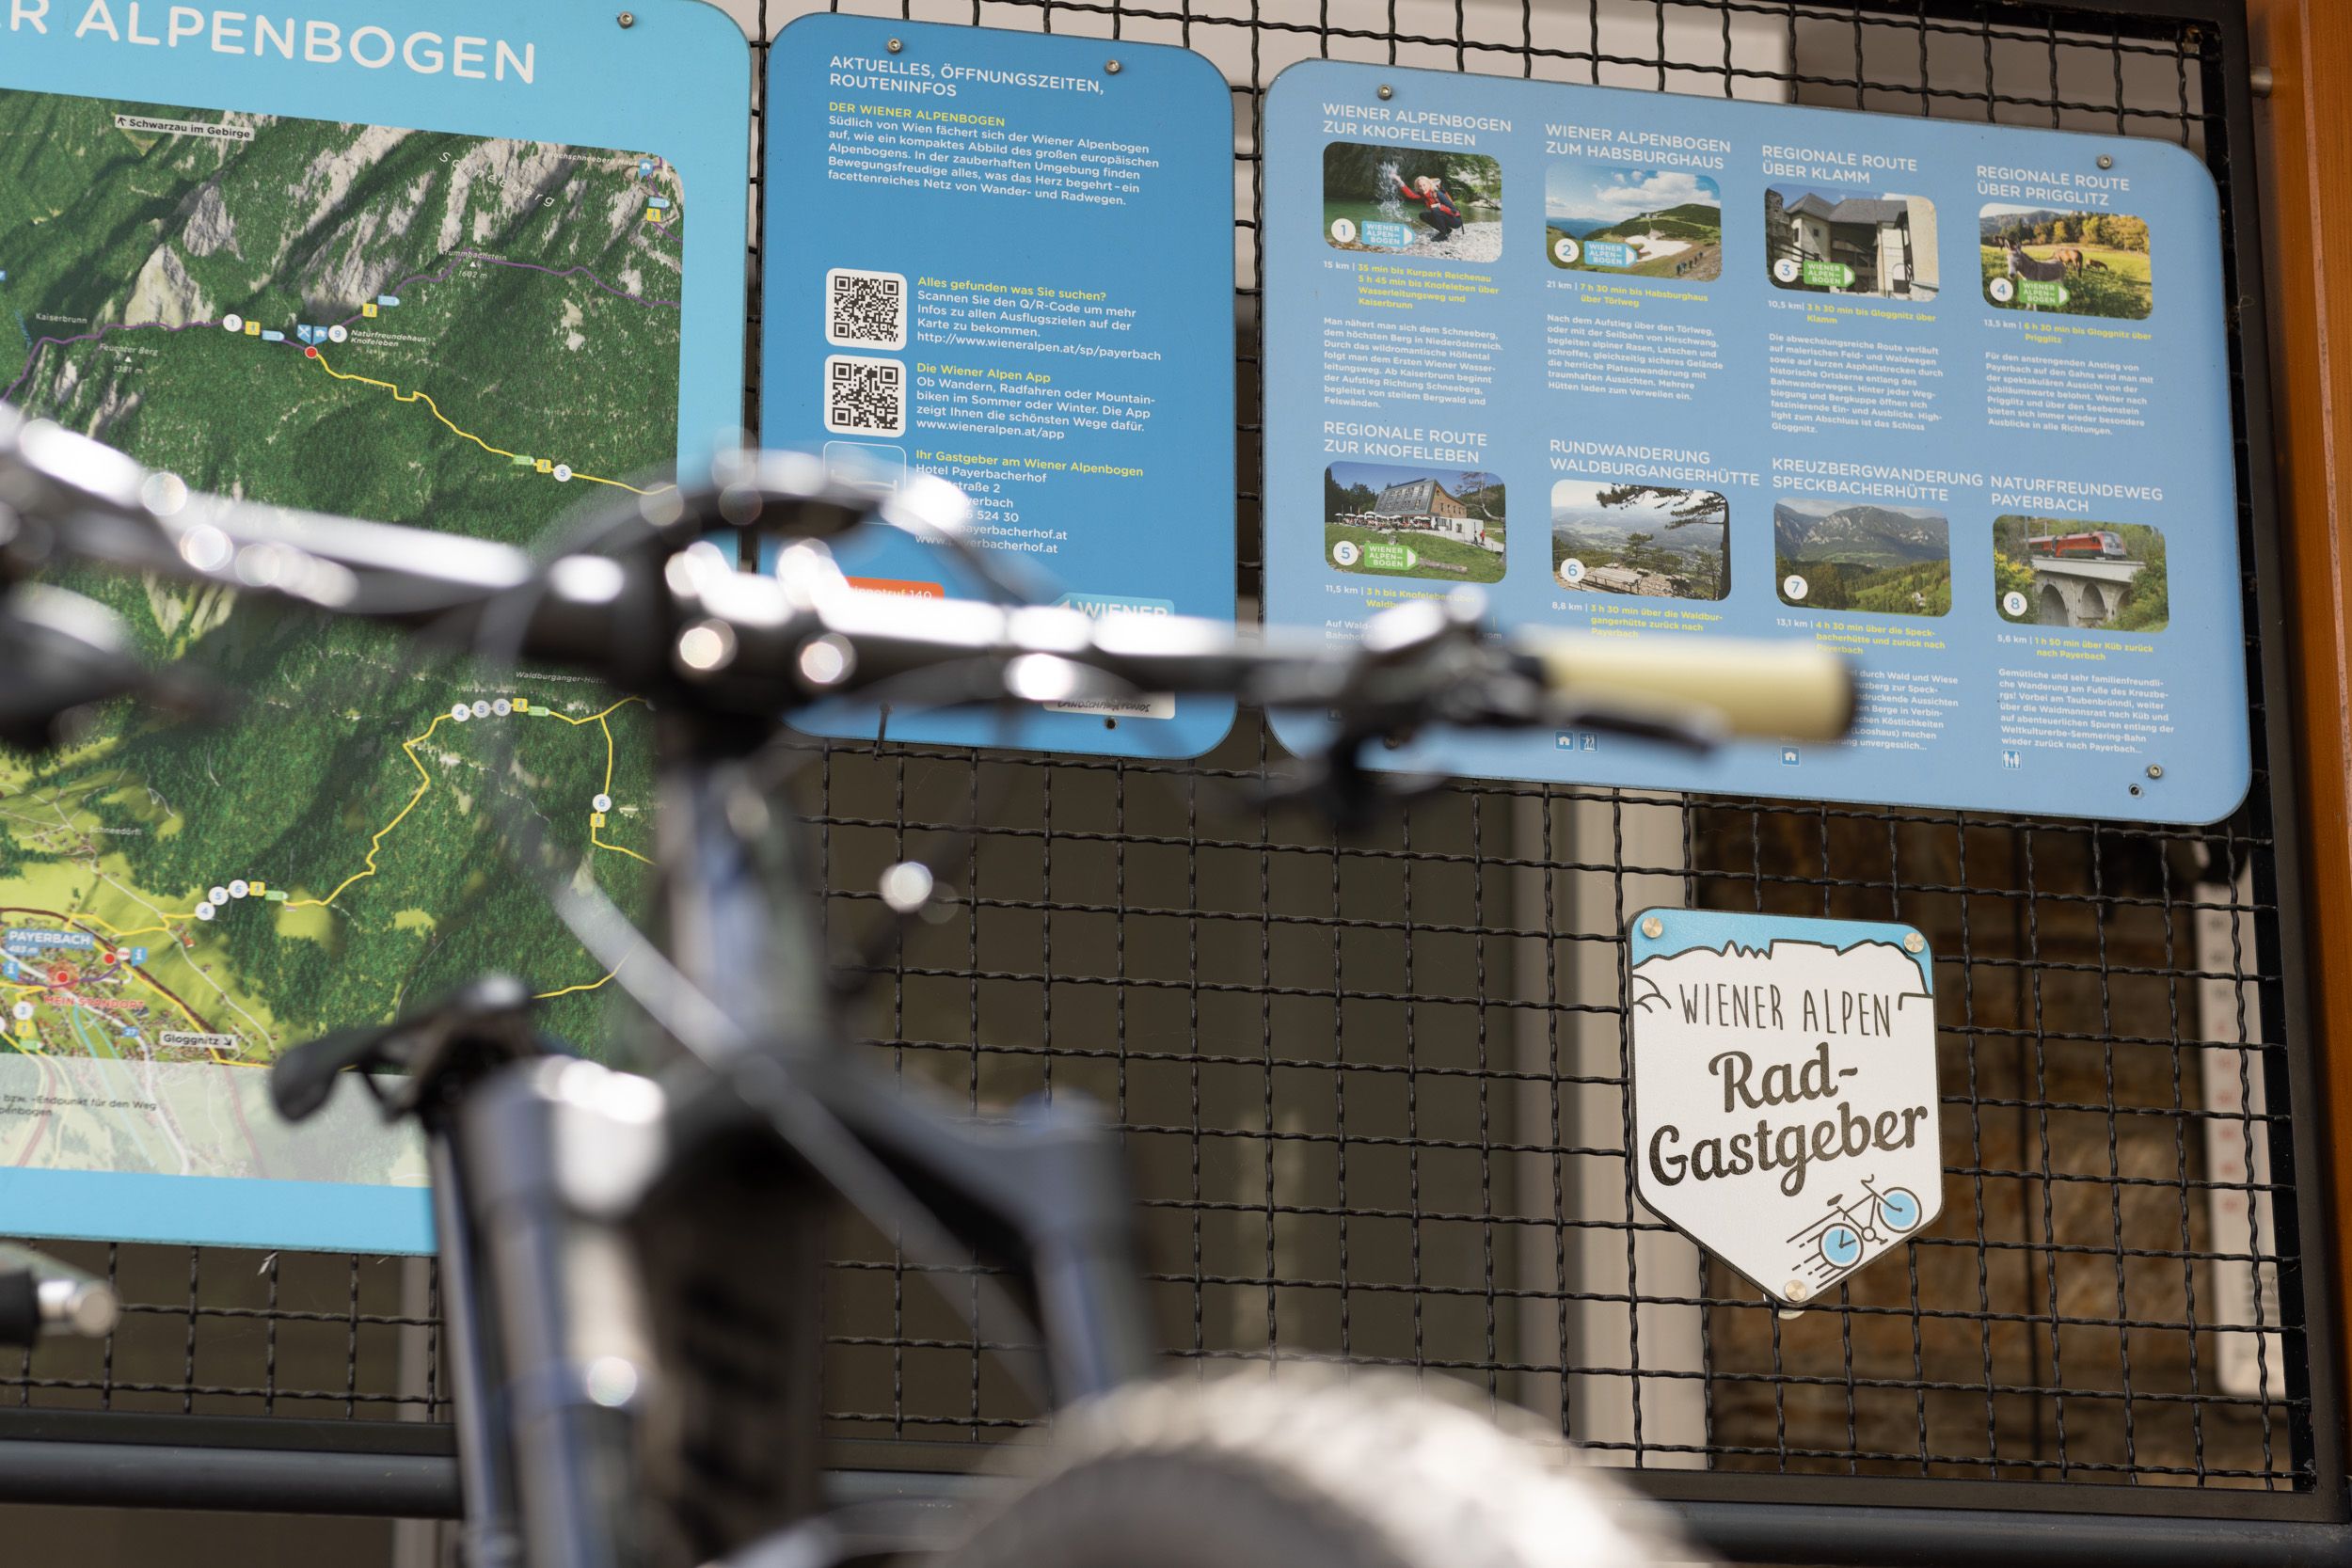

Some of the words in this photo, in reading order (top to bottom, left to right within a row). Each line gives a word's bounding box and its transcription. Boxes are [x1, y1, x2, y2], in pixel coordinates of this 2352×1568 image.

[75, 0, 534, 84] ALPENBOGEN
[830, 55, 935, 79] AKTUELLES,
[941, 63, 1104, 95] ÖFFNUNGSZEITEN,
[830, 72, 957, 97] ROUTENINFOS
[829, 102, 855, 113] DER
[860, 105, 912, 118] WIENER
[916, 110, 1005, 126] ALPENBOGEN
[1323, 103, 1391, 120] WIENER
[1395, 110, 1512, 132] ALPENBOGEN
[129, 119, 187, 132] Schwarzau
[190, 124, 203, 134] im
[207, 126, 250, 139] Gebirge
[829, 115, 873, 128] Südlich
[876, 121, 898, 131] von
[902, 122, 932, 134] Wien
[936, 125, 977, 138] fächert
[981, 130, 1005, 140] sich
[1008, 132, 1028, 142] der
[1031, 135, 1073, 147] Wiener
[1077, 138, 1149, 153] Alpenbogen
[1323, 120, 1358, 135] ZUR
[1363, 124, 1476, 146] KNOFELEBEN
[1546, 124, 1612, 141] WIENER
[1617, 131, 1731, 152] ALPENBOGEN
[828, 130, 850, 141] auf,
[853, 132, 874, 142] wie
[878, 134, 896, 144] ein
[899, 135, 964, 150] kompaktes
[968, 142, 1008, 154] Abbild
[1010, 146, 1032, 156] des
[1035, 150, 1077, 160] großen
[1080, 154, 1159, 167] europäischen
[1546, 141, 1581, 155] ZUM
[1587, 145, 1724, 169] HABSBURGHAUS
[1762, 145, 1857, 166] REGIONALE
[1862, 154, 1917, 171] ROUTE
[828, 142, 911, 159] Alpenbogens.
[914, 150, 926, 160] In
[929, 151, 949, 162] der
[953, 155, 1031, 169] zauberhaften
[1035, 162, 1100, 178] Umgebung
[1104, 167, 1140, 180] finden
[1763, 160, 1806, 178] ÜBER
[1811, 166, 1870, 183] KLAMM
[828, 156, 947, 177] Bewegungsfreudige
[951, 167, 981, 180] alles,
[984, 172, 1008, 181] was
[1010, 173, 1032, 183] das
[1035, 175, 1062, 186] Herz
[1066, 178, 1112, 191] begehrt
[1121, 183, 1139, 193] ein
[1977, 166, 2070, 185] REGIONALE
[2074, 174, 2129, 191] ROUTE
[828, 169, 920, 187] facettenreiches
[924, 179, 951, 190] Netz
[955, 183, 977, 192] von
[980, 183, 1031, 196] Wander-
[1035, 190, 1057, 199] und
[1061, 190, 1126, 205] Radwegen.
[1978, 178, 2021, 198] ÜBER
[2026, 186, 2108, 206] PRIGGLITZ
[1341, 224, 1345, 235] 1
[1563, 245, 1570, 256] 2
[1782, 264, 1790, 276] 3
[917, 277, 946, 288] Alles
[950, 280, 1008, 293] gefunden
[1010, 286, 1034, 295] was
[1037, 287, 1055, 297] Sie
[1058, 290, 1106, 301] suchen?
[1997, 284, 2005, 294] 4
[36, 312, 87, 324] Kaiserbrunn
[351, 329, 426, 342] Naturfreundehaus
[351, 337, 399, 347] Knofeleben
[917, 331, 1161, 360] http://www.wieneralpen.at/sp/payerbach
[138, 347, 158, 356] Berg
[917, 362, 937, 373] Die
[940, 365, 983, 377] Wiener
[987, 369, 1022, 381] Alpen
[1025, 372, 1051, 384] App
[916, 420, 1065, 440] www.wieneralpen.at/app
[1324, 421, 1423, 441] REGIONALE
[1429, 430, 1487, 446] ROUTE
[1324, 439, 1359, 453] ZUR
[1364, 442, 1479, 463] KNOFELEBEN
[1550, 439, 1710, 465] RUNDWANDERUNG
[560, 468, 566, 477] 5
[916, 450, 932, 460] Ihr
[936, 451, 998, 465] Gastgeber
[1002, 458, 1020, 467] am
[1024, 458, 1067, 470] Wiener
[1071, 462, 1143, 477] Alpenbogen
[916, 464, 948, 474] Hotel
[952, 467, 1047, 483] Payerbacherhof
[1549, 452, 1759, 486] WALDBURGANGERHÜTTE
[1772, 458, 1983, 486] KREUZBERGWANDERUNG
[993, 483, 1001, 494] 2
[1772, 475, 1948, 501] SPECKBACHERHÜTTE
[1991, 475, 2163, 500] NATURFREUNDEWEG
[1992, 493, 2089, 512] PAYERBACH
[977, 511, 999, 521] 524
[1003, 513, 1020, 523] 30
[1342, 546, 1350, 559] 5
[1568, 564, 1577, 577] 6
[1791, 580, 1800, 593] 7
[2010, 597, 2019, 609] 8
[8, 931, 91, 945] PAYERBACH
[43, 995, 74, 1006] MEIN
[77, 997, 145, 1009] STANDORT
[1679, 983, 1784, 1031] WIENER
[1804, 989, 1891, 1037] ALPEN
[163, 1034, 218, 1046] Gloggnitz
[1708, 1041, 1858, 1113] Rad-
[1649, 1101, 1928, 1197] Gastgeber
